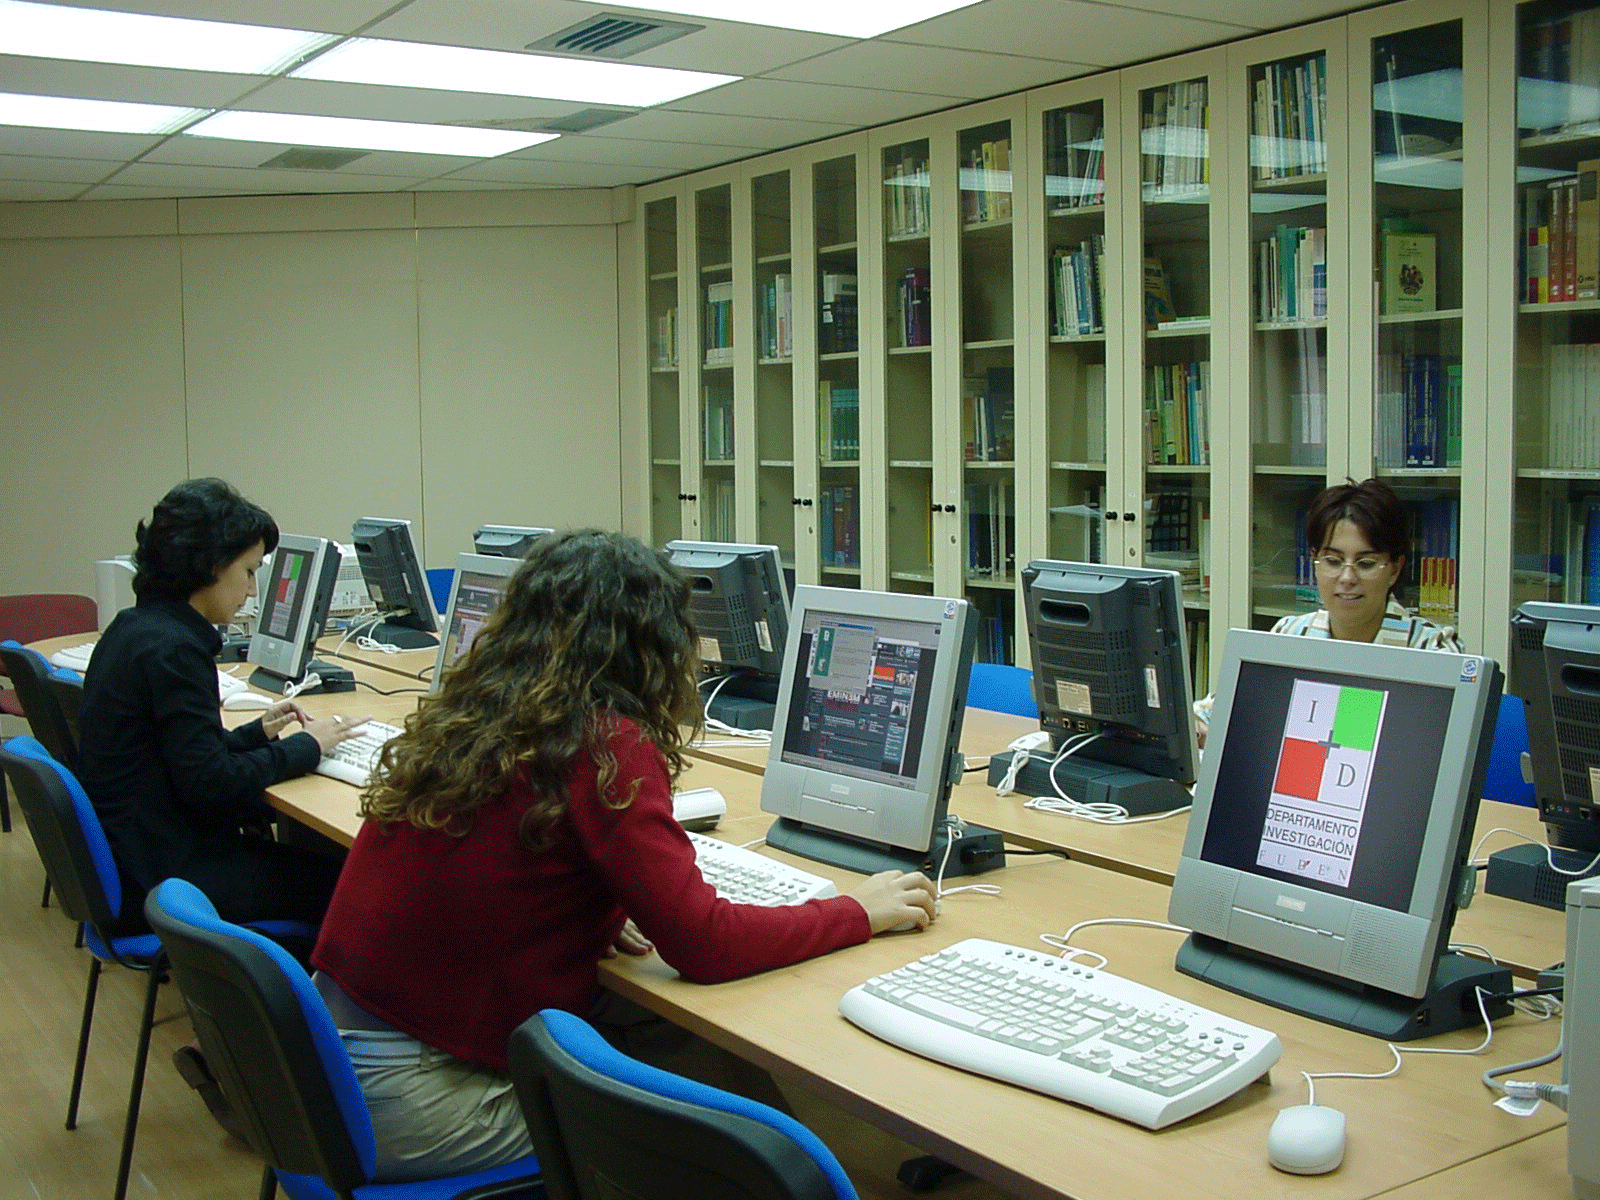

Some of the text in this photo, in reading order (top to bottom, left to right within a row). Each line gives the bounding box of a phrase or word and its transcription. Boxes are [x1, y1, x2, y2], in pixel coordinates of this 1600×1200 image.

[1336, 762, 1356, 788] D
[1266, 808, 1358, 838] DEPARTAMENTO
[1263, 825, 1354, 856] INVESTIGACIÓN
